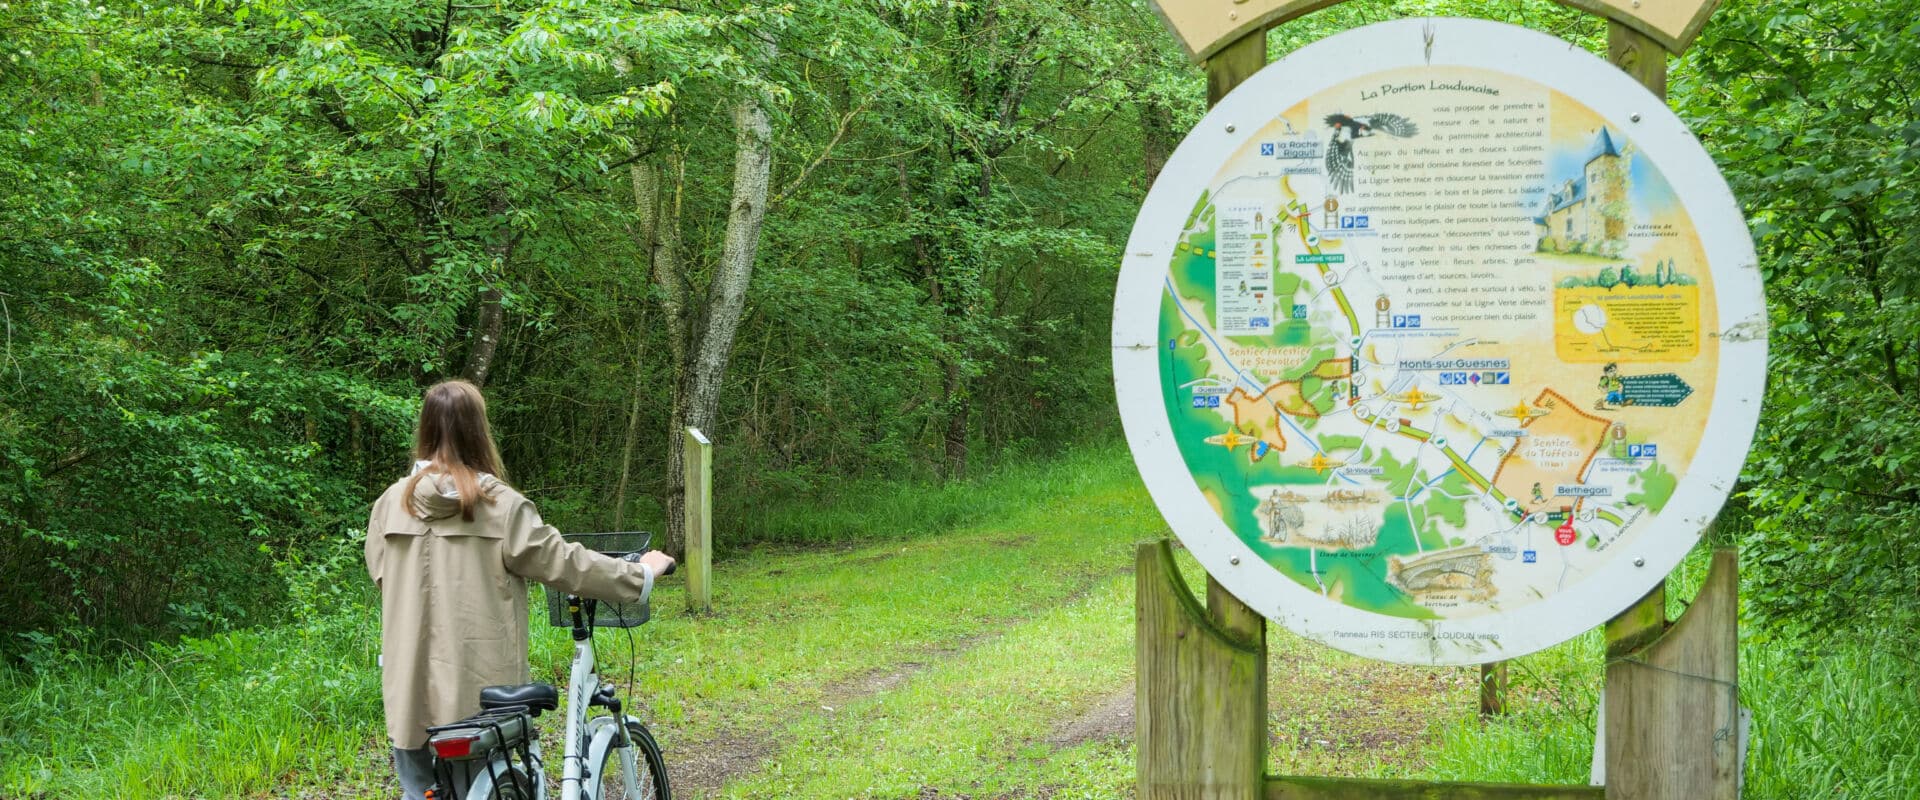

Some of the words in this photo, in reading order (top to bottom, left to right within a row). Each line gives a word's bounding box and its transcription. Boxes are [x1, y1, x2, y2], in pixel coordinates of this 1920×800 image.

[1360, 90, 1378, 101] La
[1381, 83, 1426, 96] Portion
[1430, 80, 1500, 96] Loudunaise
[1454, 105, 1485, 113] propose
[1503, 102, 1533, 111] prendre
[1449, 132, 1489, 141] patrimoine
[1374, 150, 1392, 158] pays
[1404, 162, 1424, 171] grand
[1370, 177, 1390, 186] Ligne
[1433, 203, 1455, 211] plaisir
[1456, 216, 1488, 224] parcours
[1491, 215, 1532, 223] botaniques
[1404, 232, 1440, 240] panneaux
[1408, 245, 1433, 254] profiter
[1394, 259, 1414, 268] Ligne
[1406, 300, 1448, 309] promenade
[1475, 299, 1495, 309] Ligne
[1450, 314, 1482, 322] procurer
[1400, 358, 1507, 369] Monts-sur-Guesnes
[1534, 438, 1571, 447] Sentier
[1526, 448, 1536, 456] du
[1539, 448, 1580, 457] Tuffeau
[1558, 485, 1608, 496] Berthegon
[1334, 630, 1368, 638] Panneau
[1371, 630, 1386, 638] RIS
[1388, 630, 1429, 639] SECTEUR
[1438, 632, 1475, 640] LOUDUN
